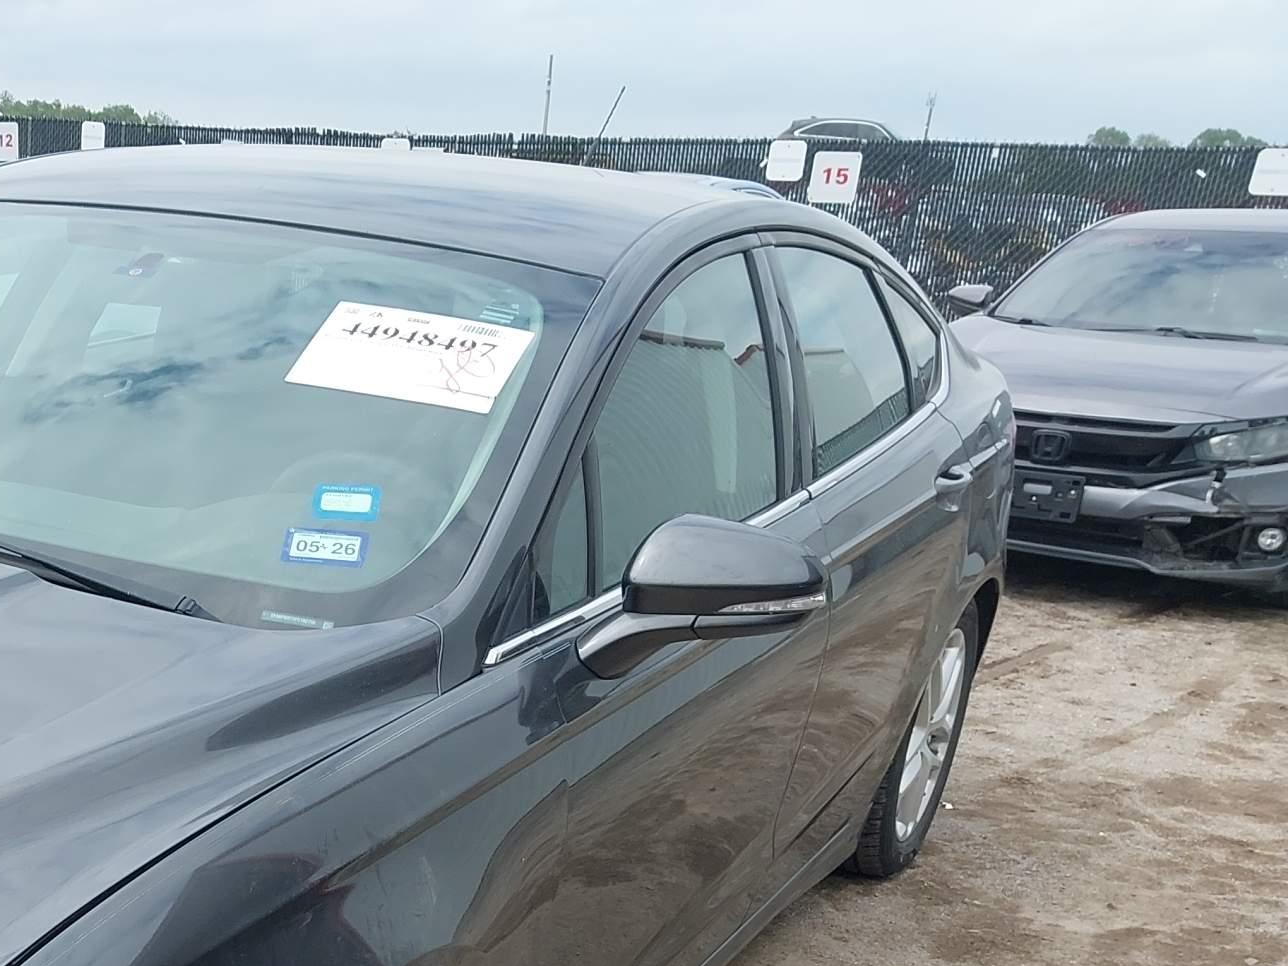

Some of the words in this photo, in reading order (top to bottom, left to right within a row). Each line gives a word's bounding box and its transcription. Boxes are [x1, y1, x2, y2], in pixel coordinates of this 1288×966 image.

[823, 168, 849, 184] 15
[341, 321, 499, 357] 44948497
[330, 542, 356, 556] 26
